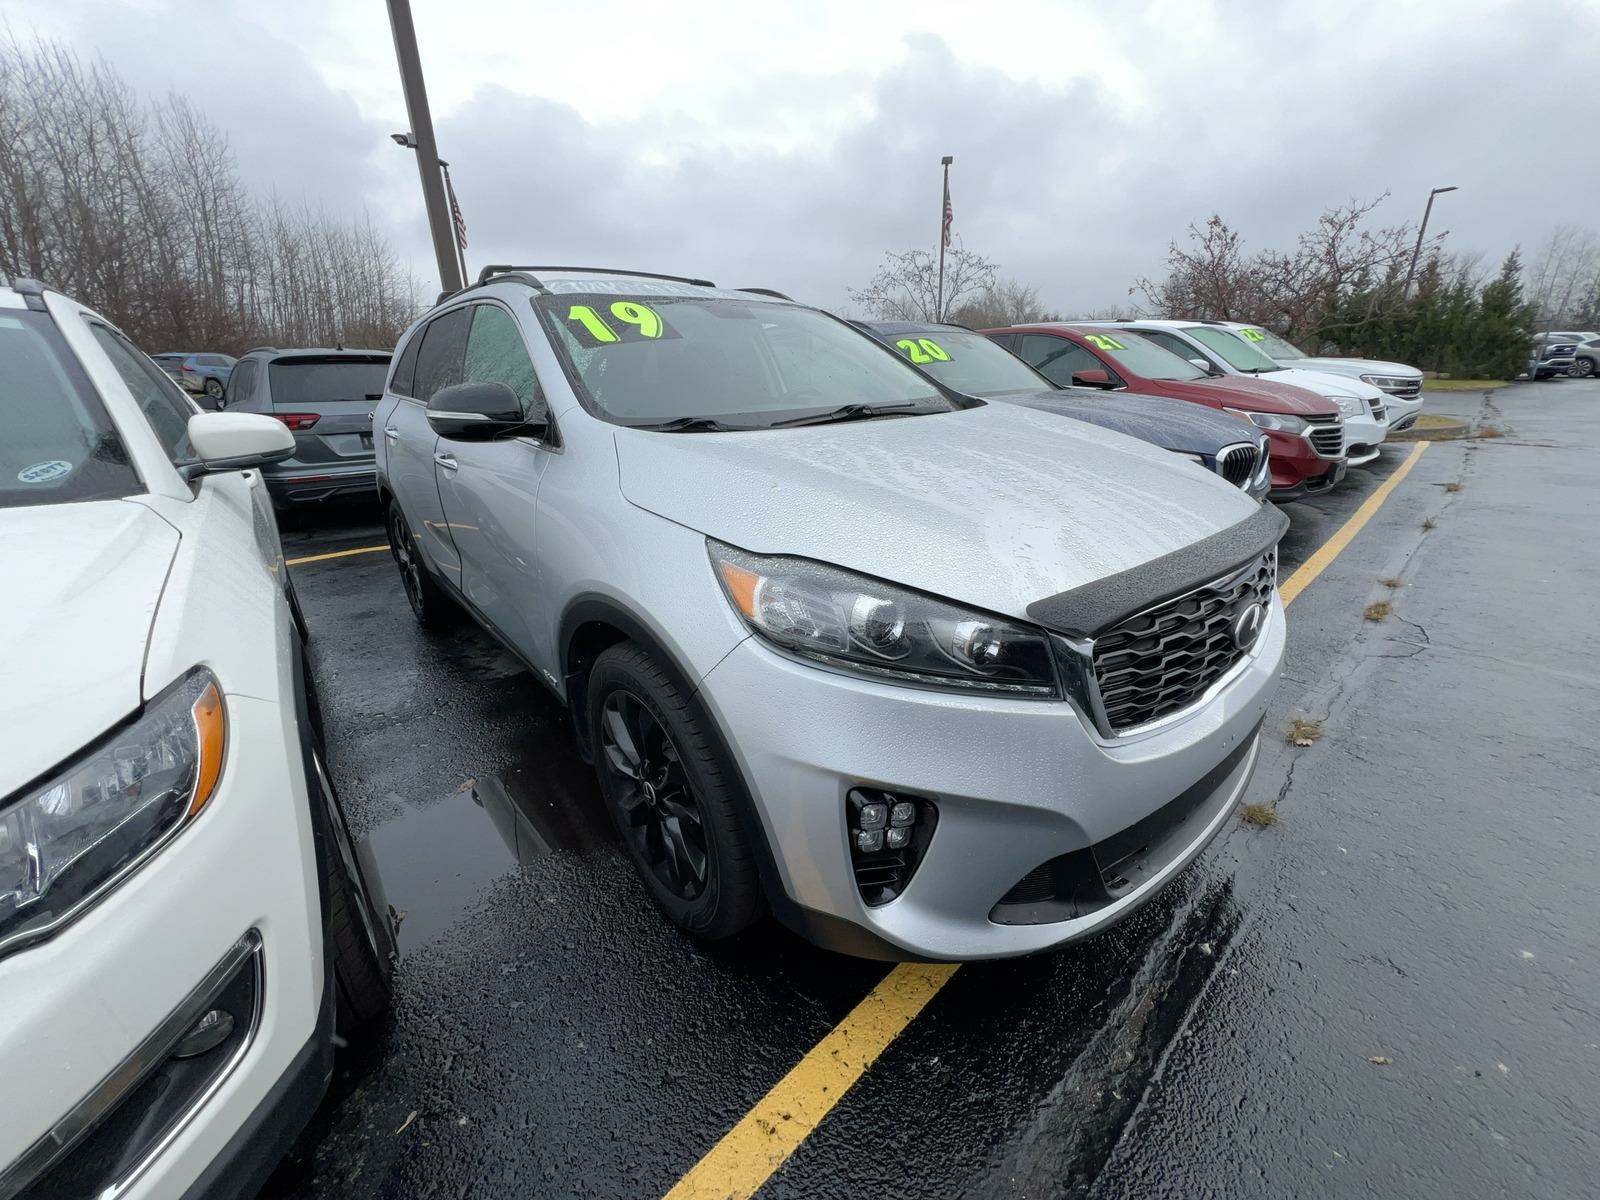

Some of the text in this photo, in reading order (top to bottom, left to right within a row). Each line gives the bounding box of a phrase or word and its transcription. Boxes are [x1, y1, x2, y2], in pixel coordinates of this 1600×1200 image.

[568, 301, 663, 342] 19
[896, 339, 951, 363] 20
[1084, 334, 1126, 351] 21
